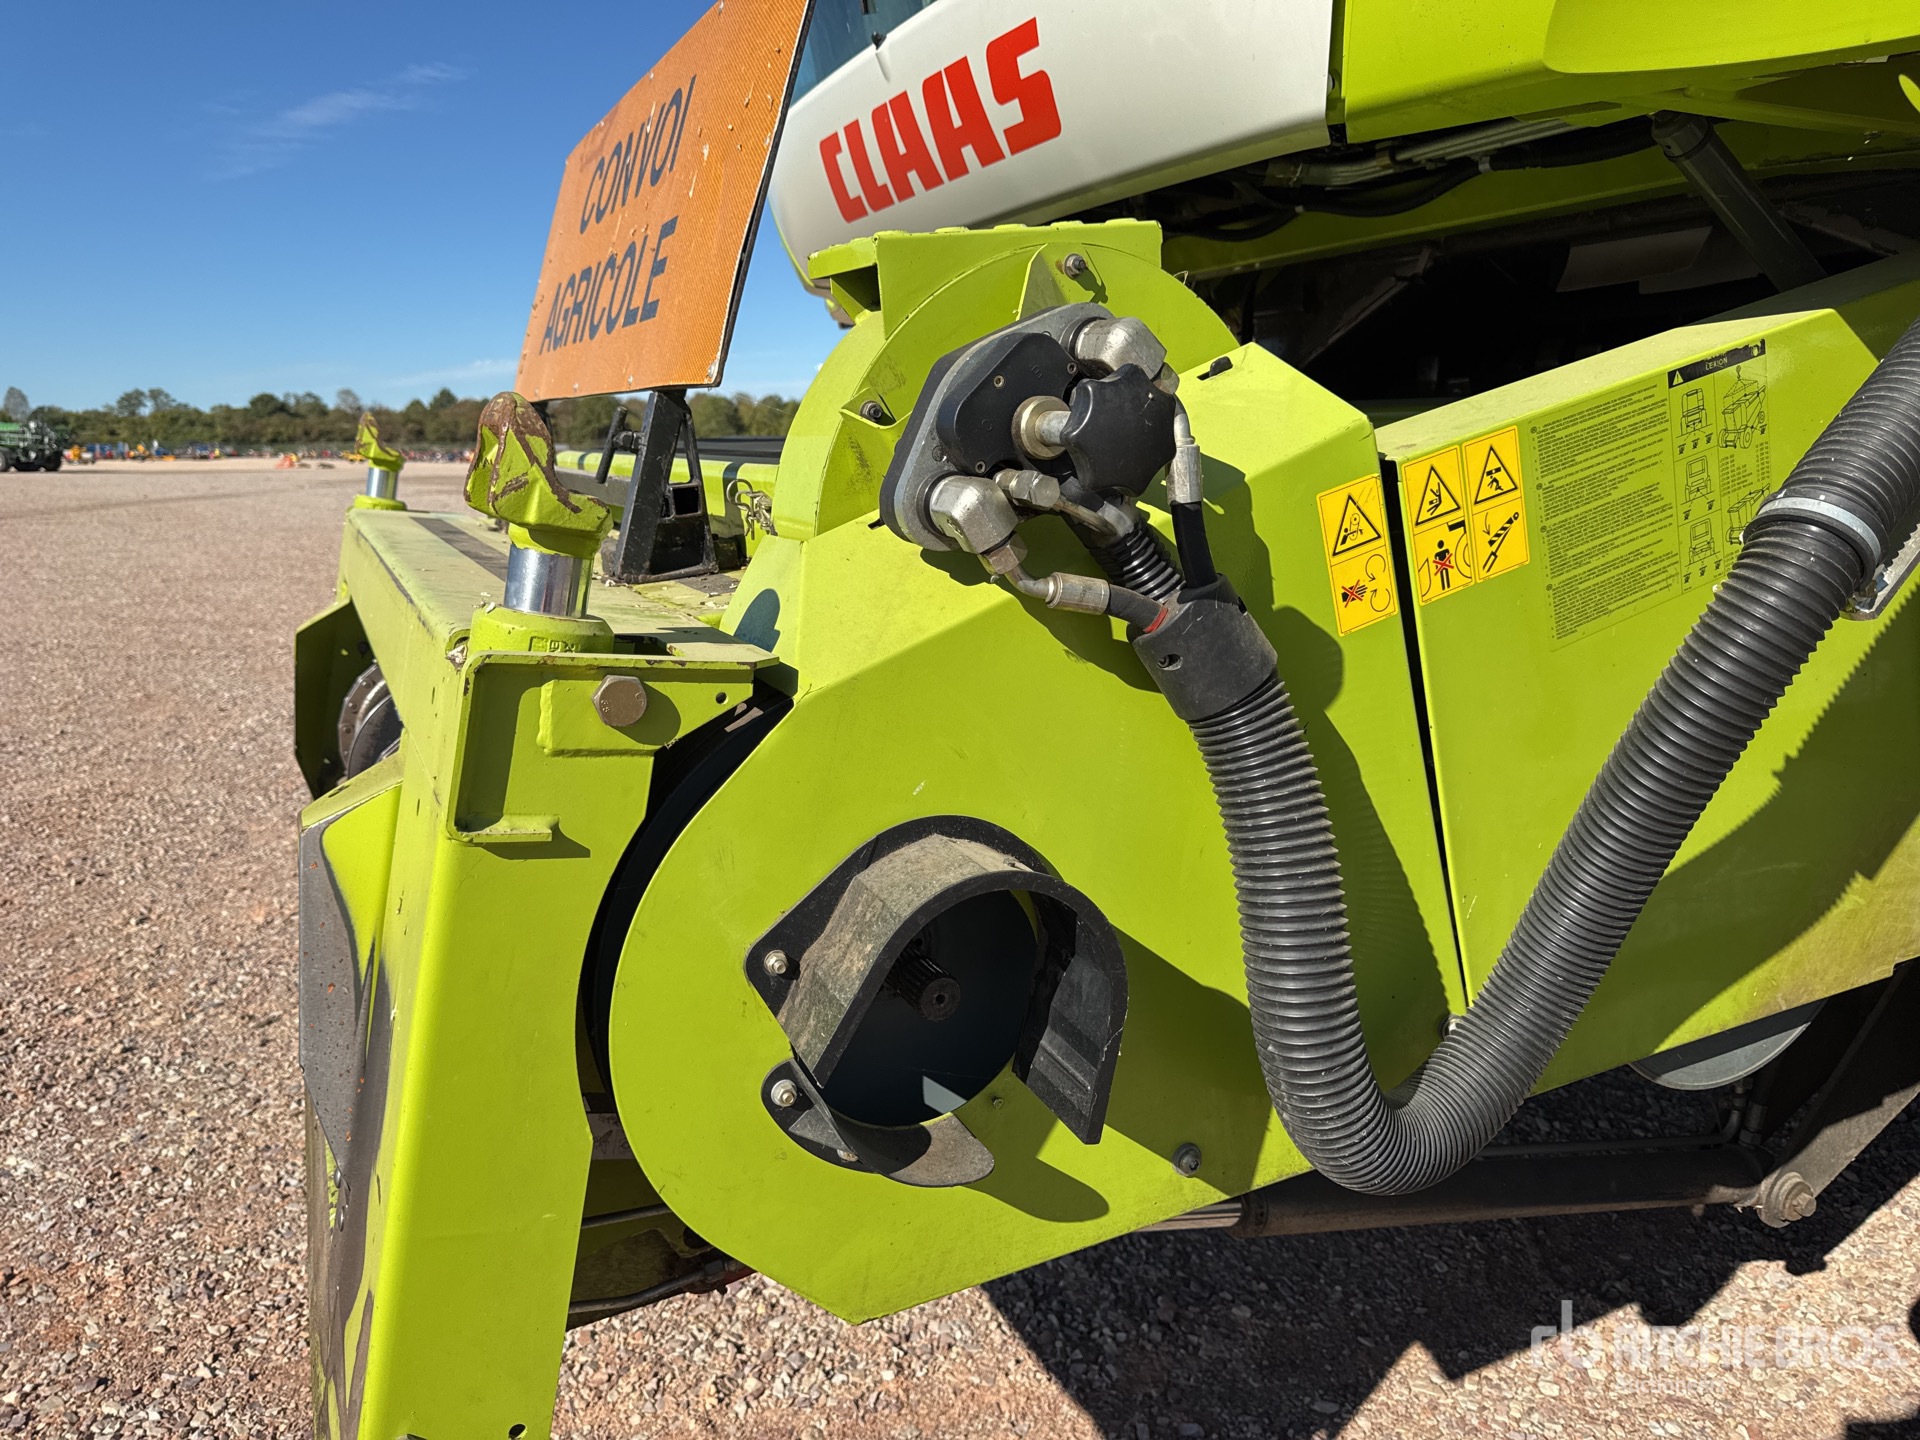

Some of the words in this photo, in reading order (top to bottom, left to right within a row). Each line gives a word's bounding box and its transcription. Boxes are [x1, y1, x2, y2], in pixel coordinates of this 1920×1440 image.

[580, 75, 697, 235] CONVOI
[819, 16, 1062, 224] CLAAS
[539, 215, 680, 355] AGRICOLE
